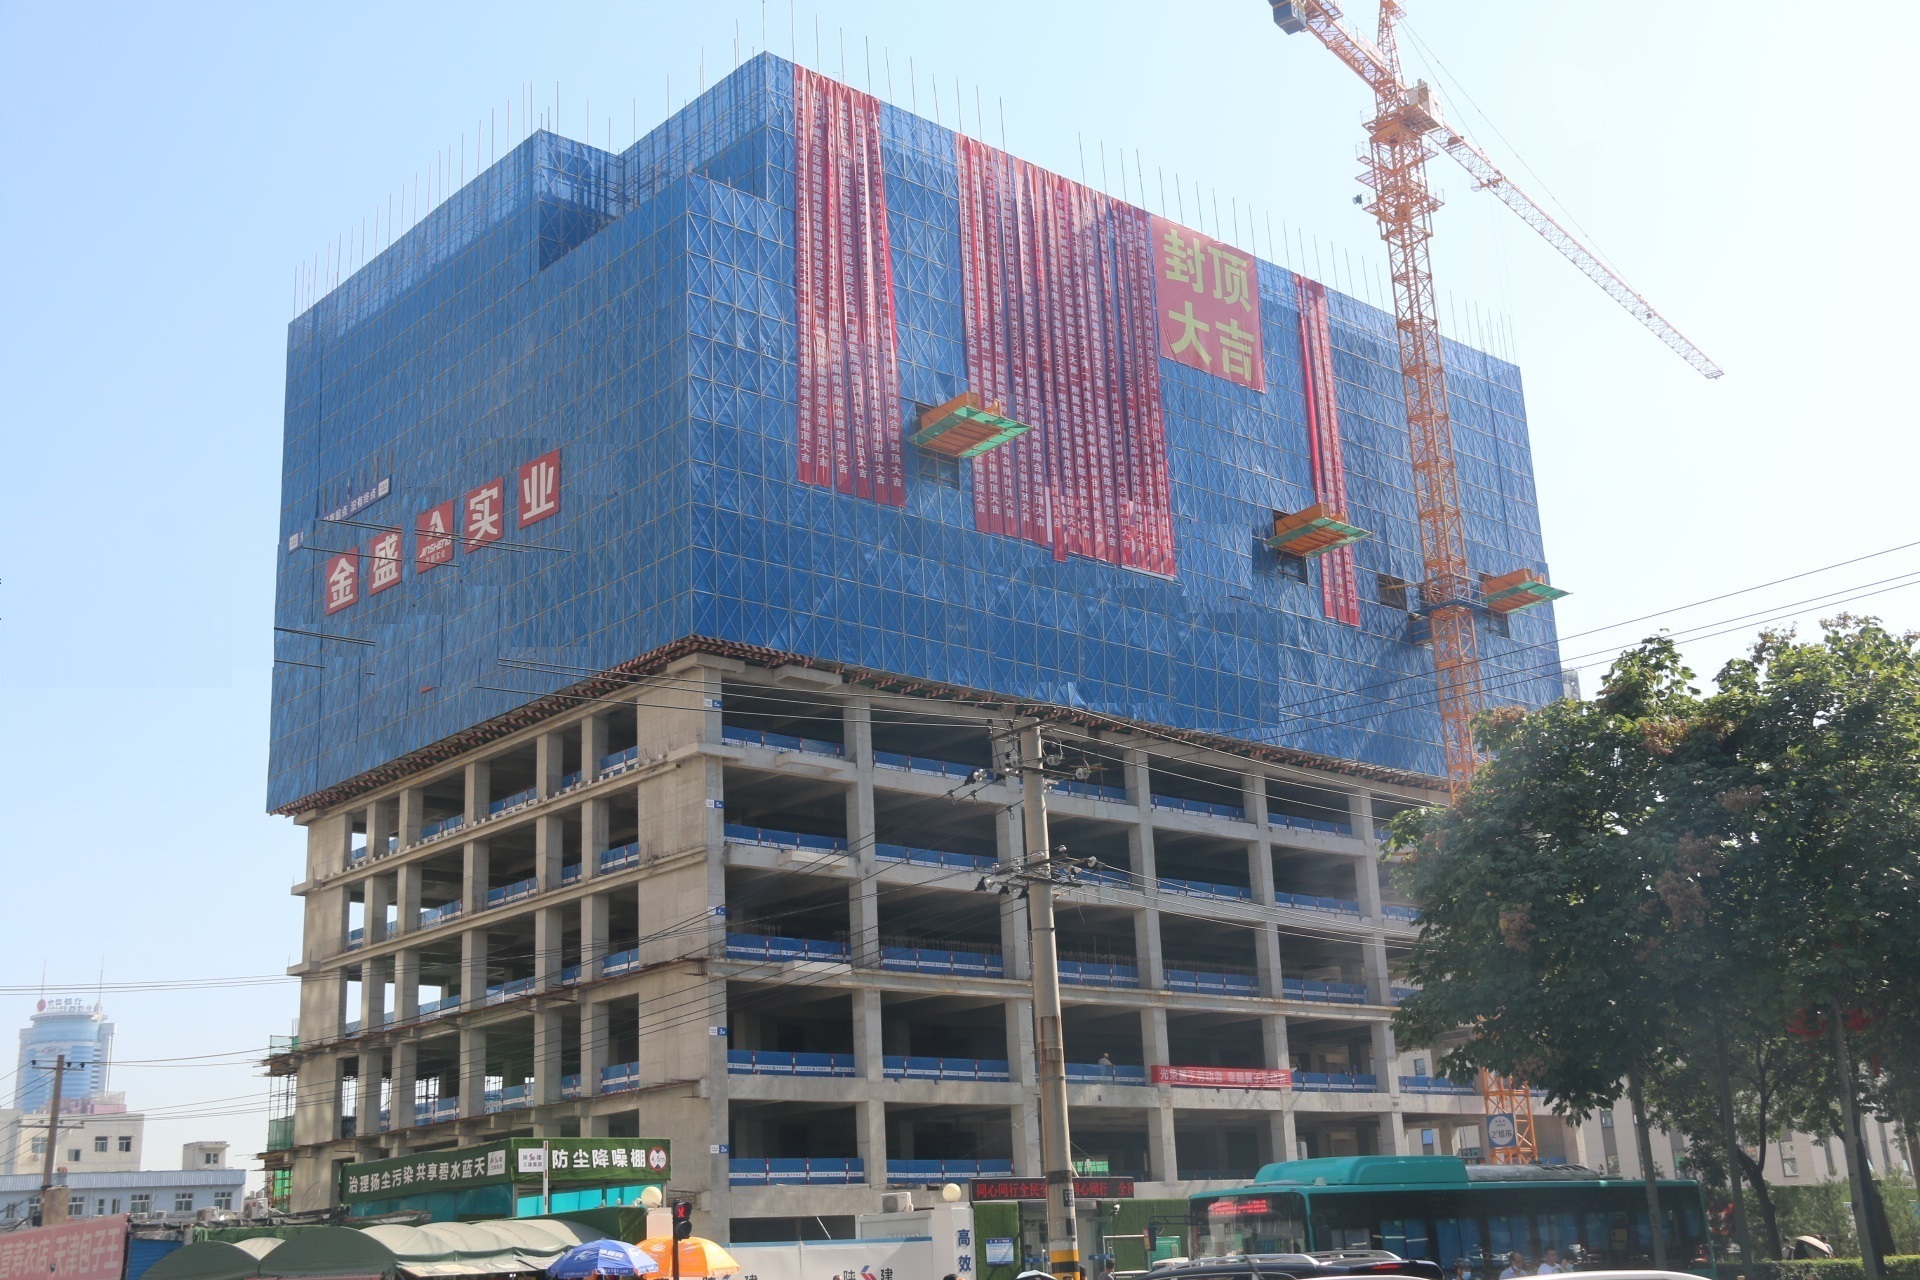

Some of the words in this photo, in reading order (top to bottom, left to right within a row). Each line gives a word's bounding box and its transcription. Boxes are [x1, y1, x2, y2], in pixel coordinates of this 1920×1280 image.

[1163, 228, 1252, 313] 封顶
[1168, 300, 1255, 382] 大吉
[348, 1165, 414, 1194] 治理扬尘污染
[416, 1157, 485, 1181] 共享碧水蓝天
[552, 1148, 646, 1169] 防尘降噪棚
[53, 1228, 121, 1276] 天津包子王
[957, 1228, 972, 1273] 高效
